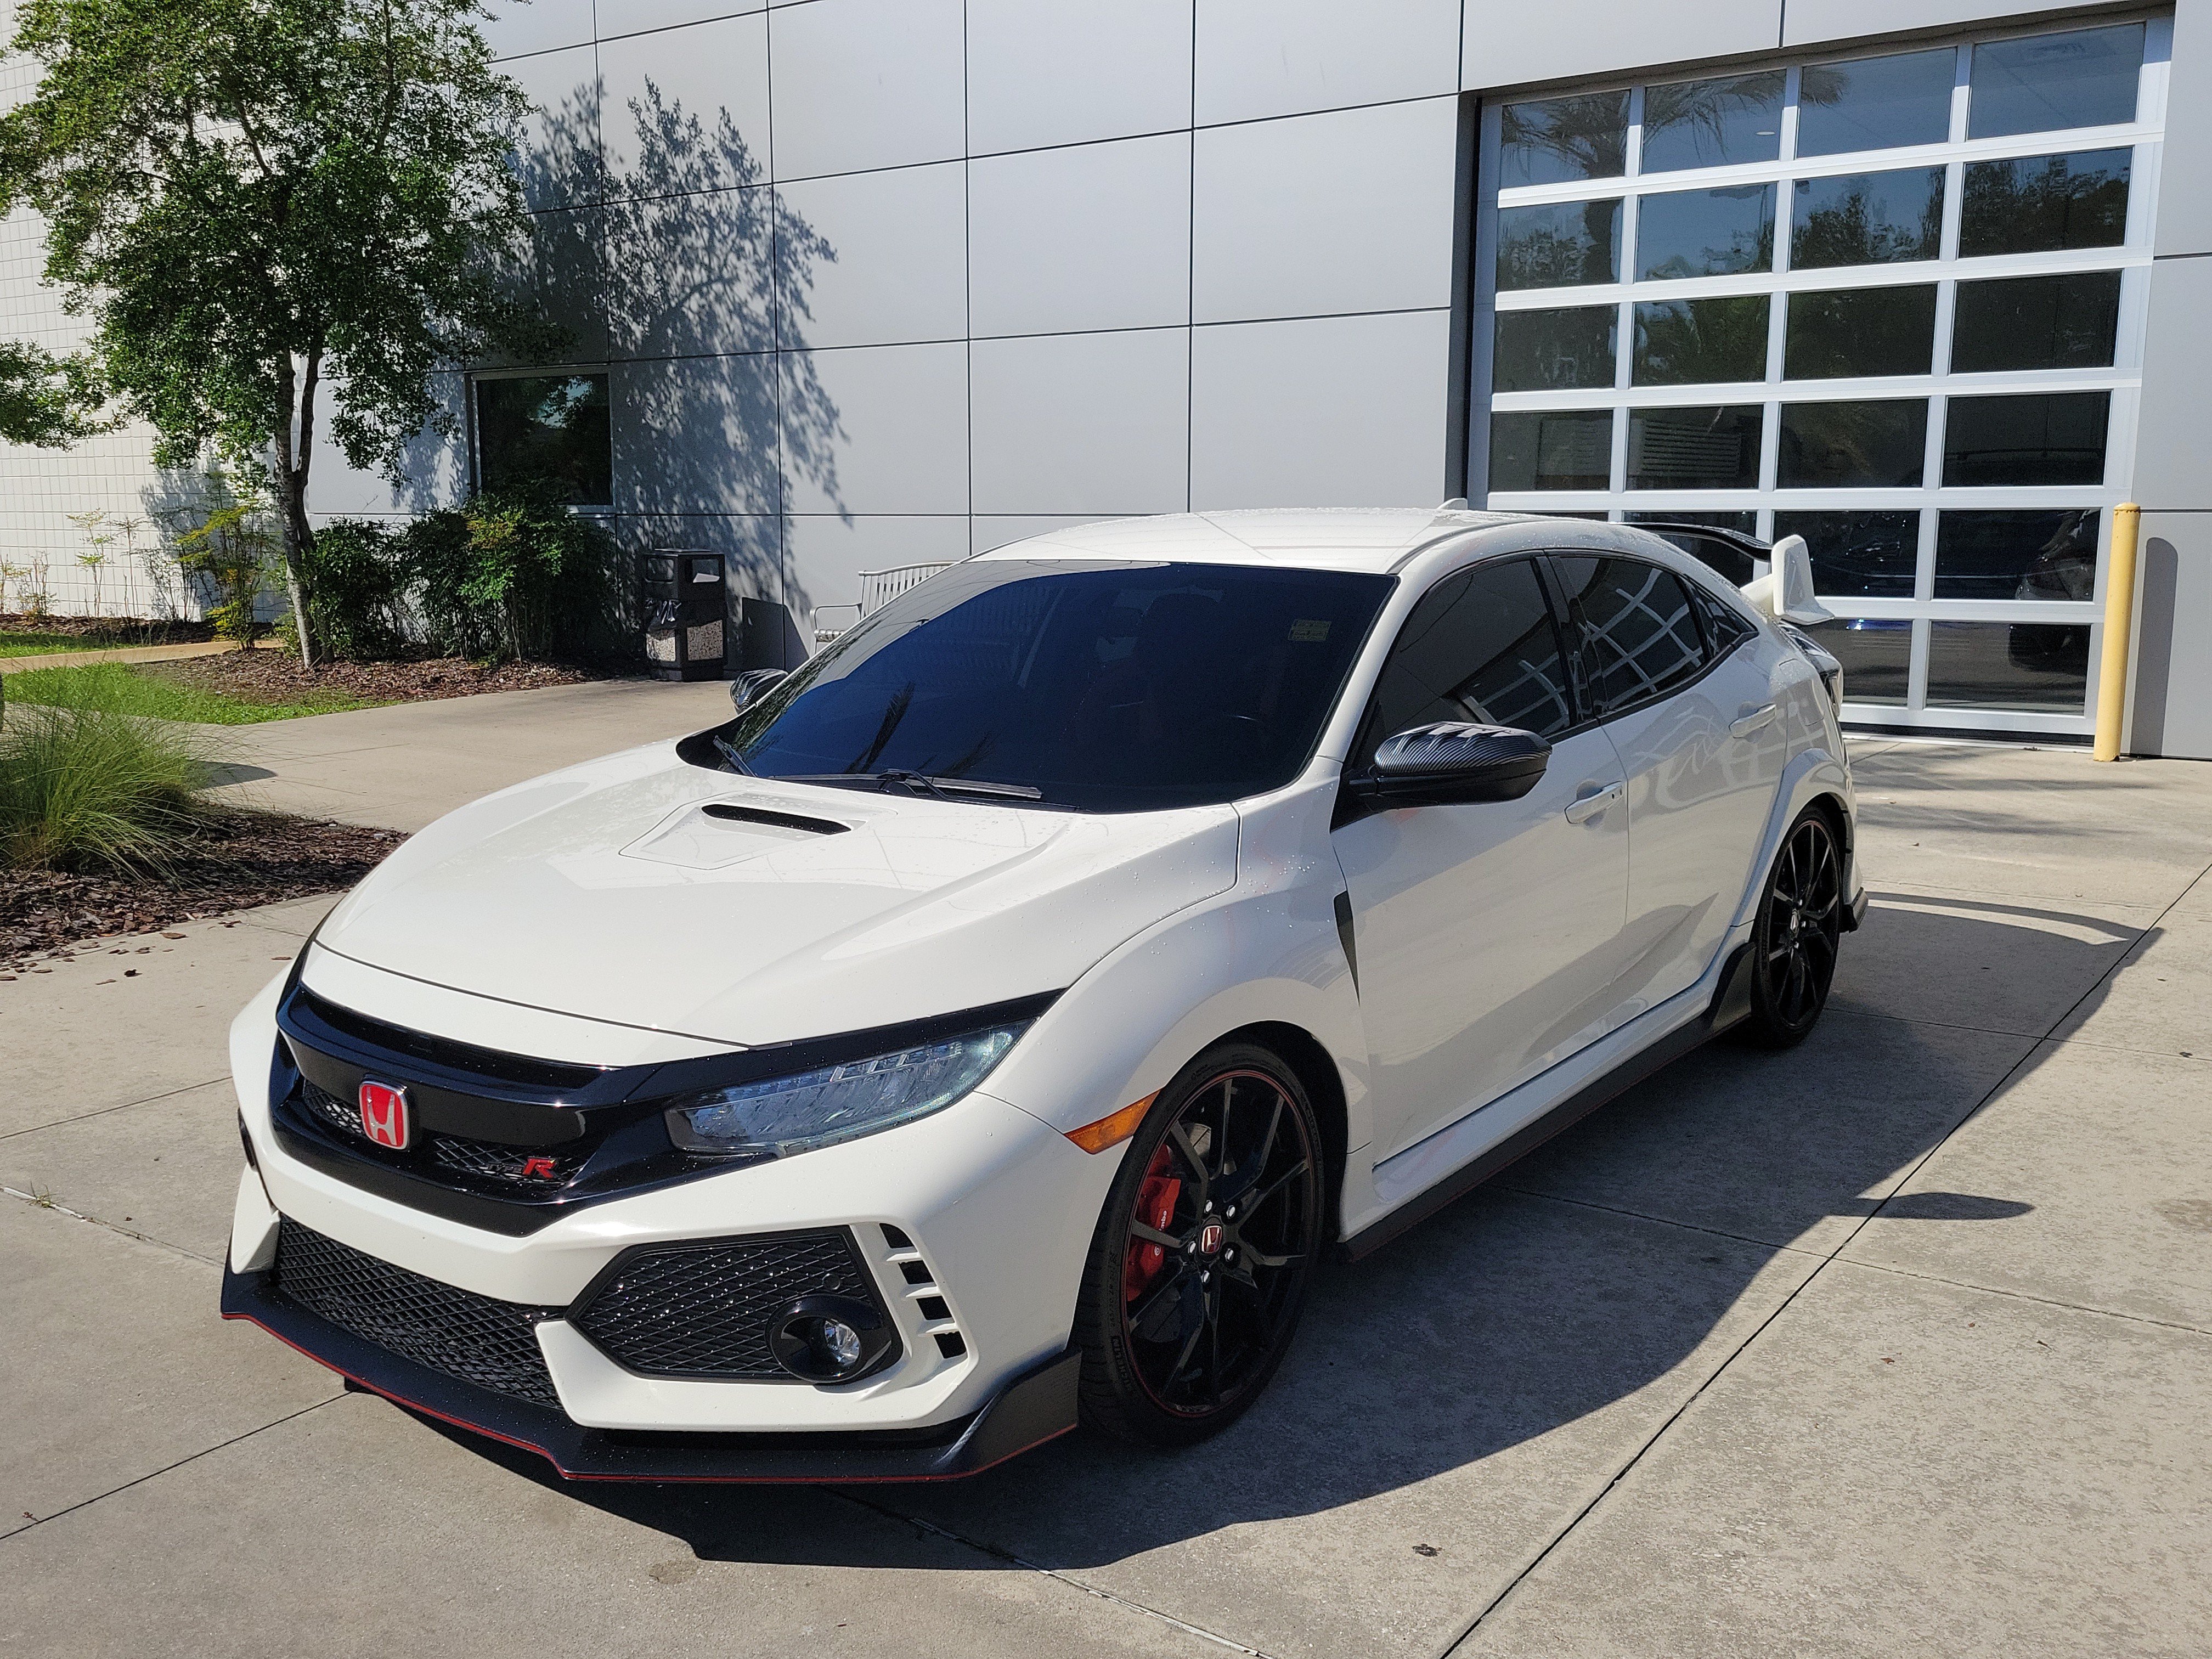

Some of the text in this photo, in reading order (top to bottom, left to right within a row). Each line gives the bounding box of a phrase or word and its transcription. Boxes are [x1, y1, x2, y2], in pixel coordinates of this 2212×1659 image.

[366, 1086, 398, 1146] H
[488, 1156, 558, 1179] TYPE R
